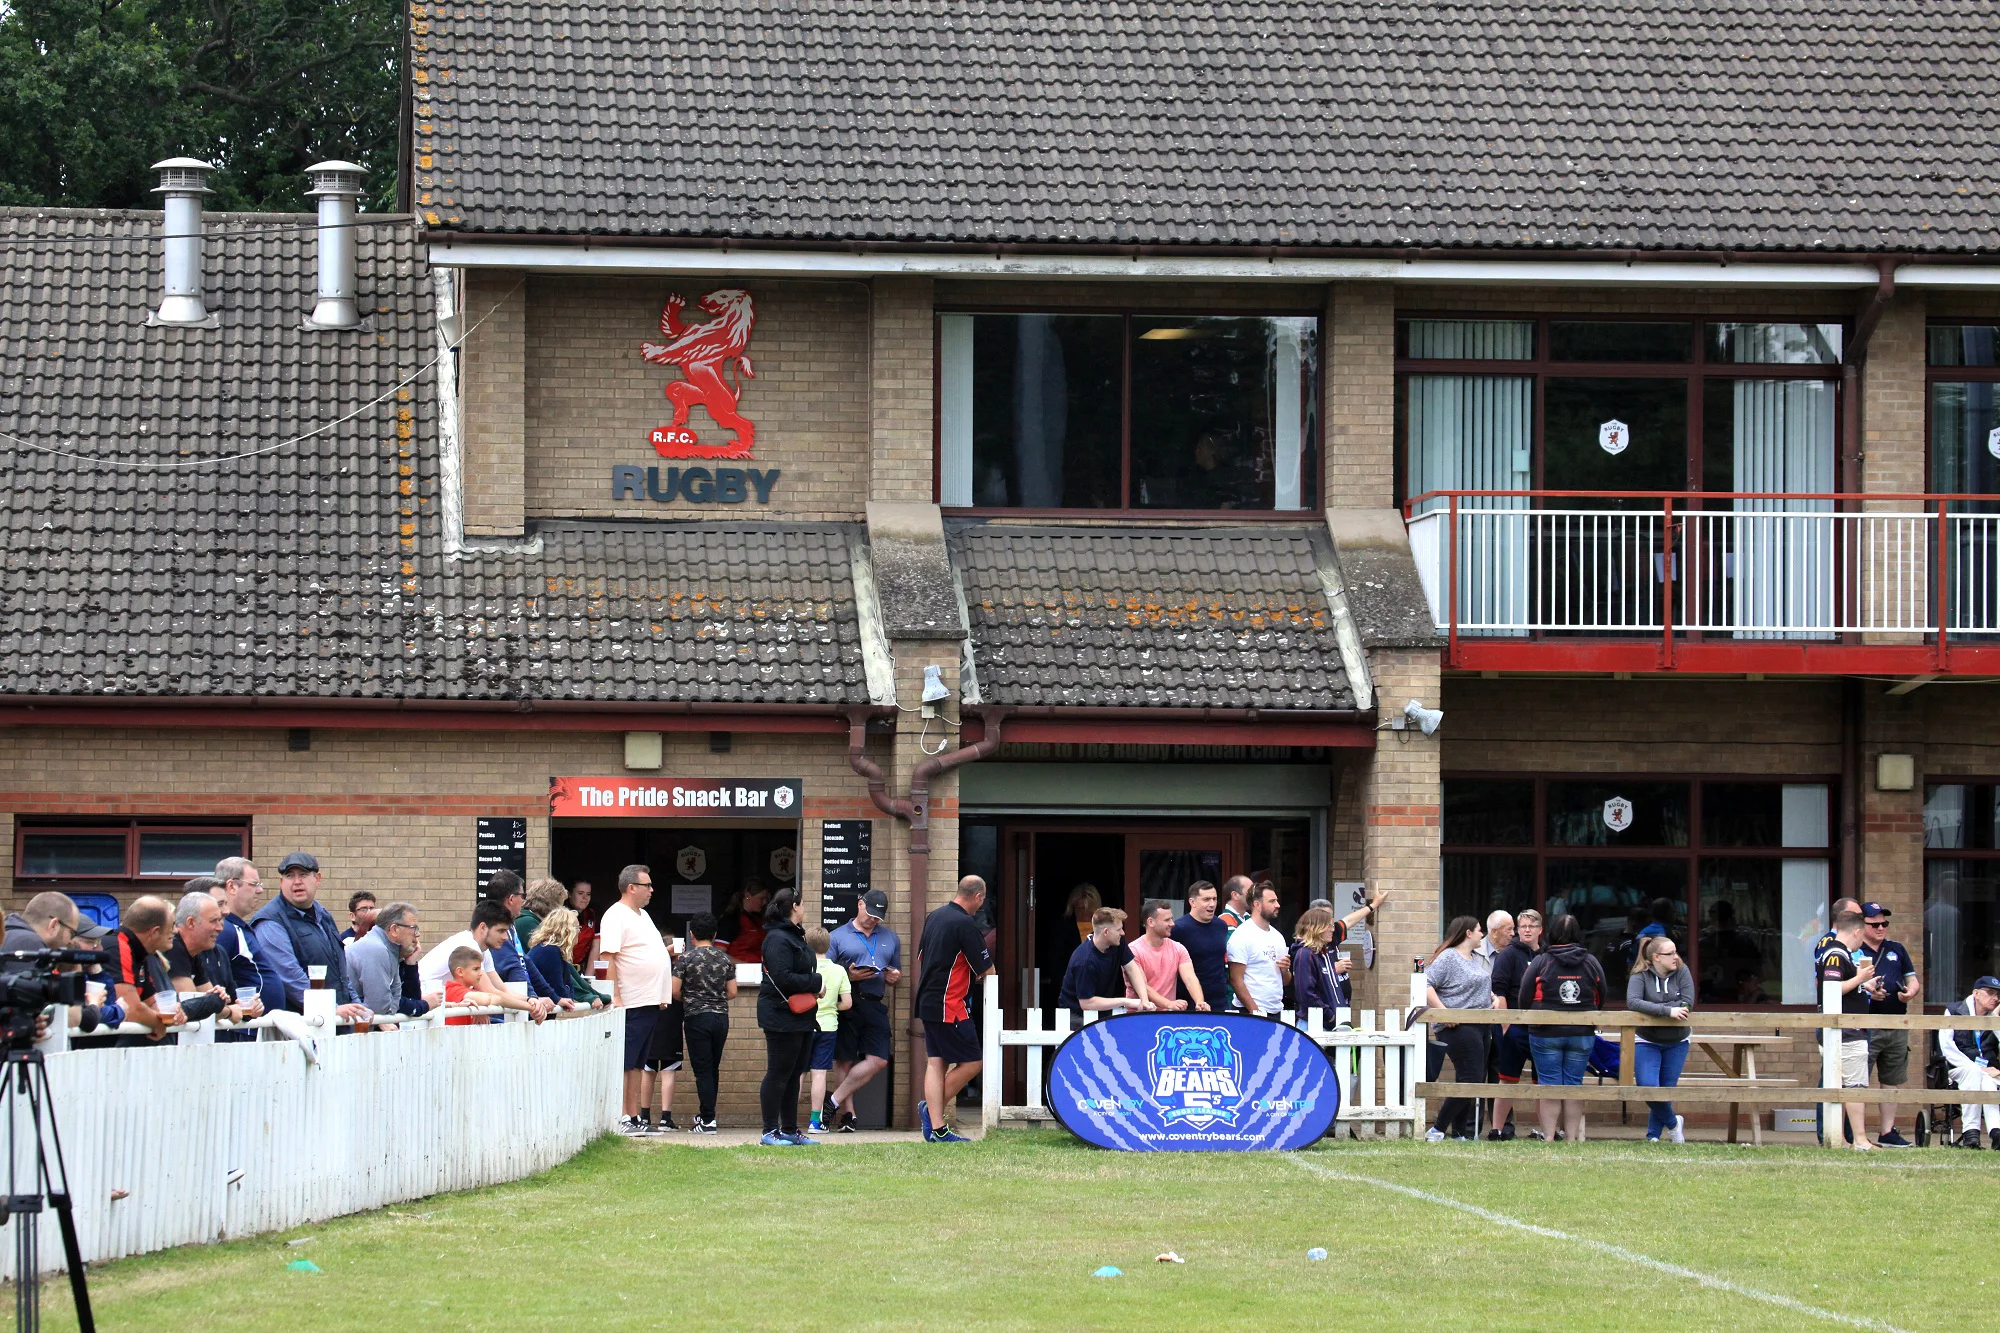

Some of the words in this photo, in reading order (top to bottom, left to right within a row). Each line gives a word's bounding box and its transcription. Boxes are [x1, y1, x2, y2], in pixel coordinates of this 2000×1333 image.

[653, 432, 694, 444] R.F.C.
[612, 465, 781, 504] RUGBY
[994, 743, 1050, 758] come
[579, 786, 614, 806] The
[618, 786, 668, 806] Pride
[672, 786, 732, 806] Snack
[734, 787, 768, 806] Bar
[1156, 1070, 1239, 1096] BEARS
[1078, 1095, 1144, 1109] COVENTRY
[1172, 1109, 1195, 1117] RUGBY
[1198, 1108, 1226, 1117] LEAGUE
[1138, 1132, 1266, 1141] www.coventrybears.com
